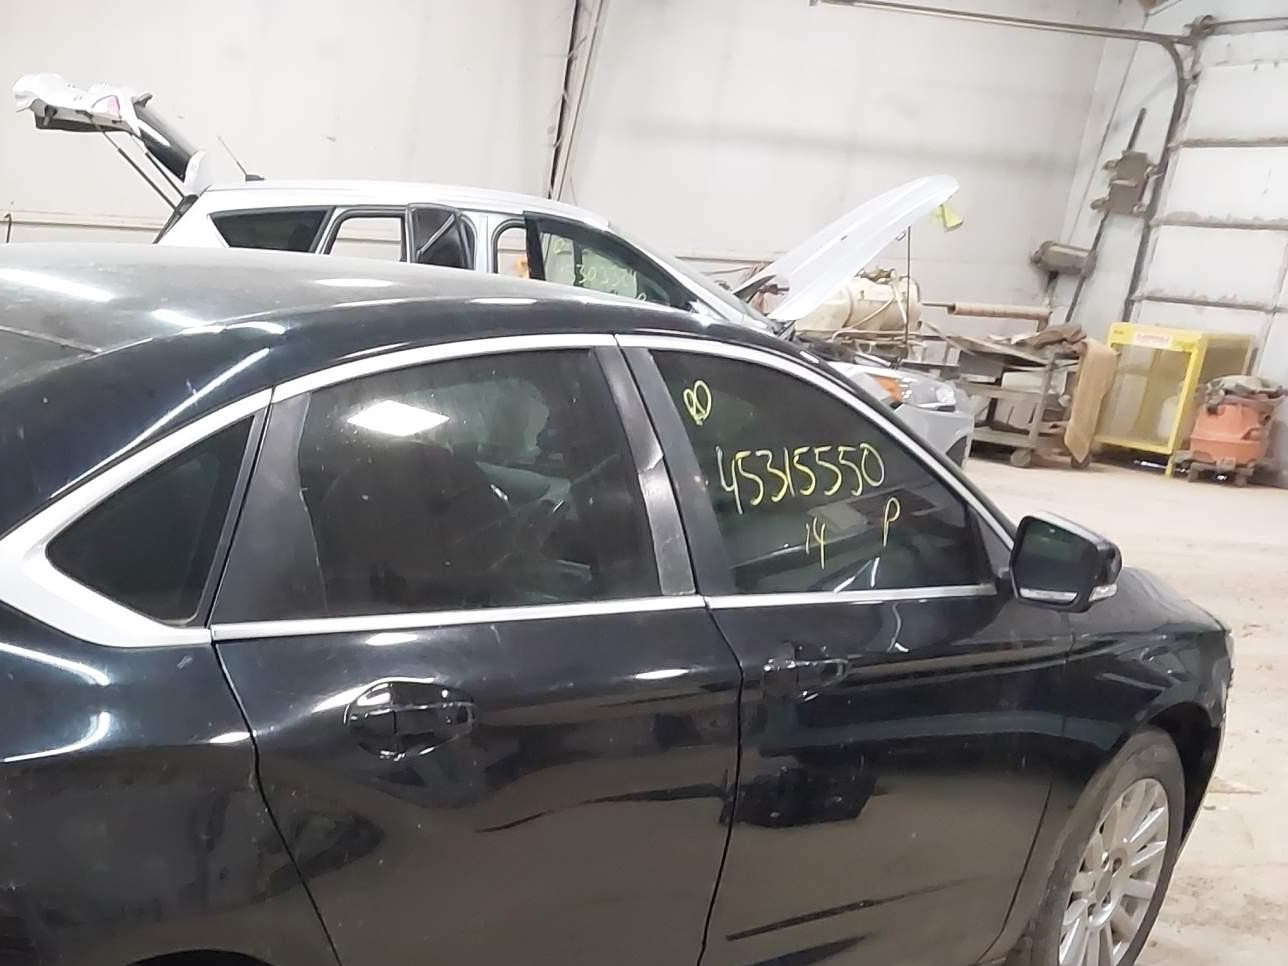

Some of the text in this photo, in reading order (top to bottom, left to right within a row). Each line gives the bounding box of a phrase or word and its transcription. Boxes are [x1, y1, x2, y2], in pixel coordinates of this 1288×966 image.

[715, 442, 885, 514] 45315550
[805, 497, 901, 569] 14 P
